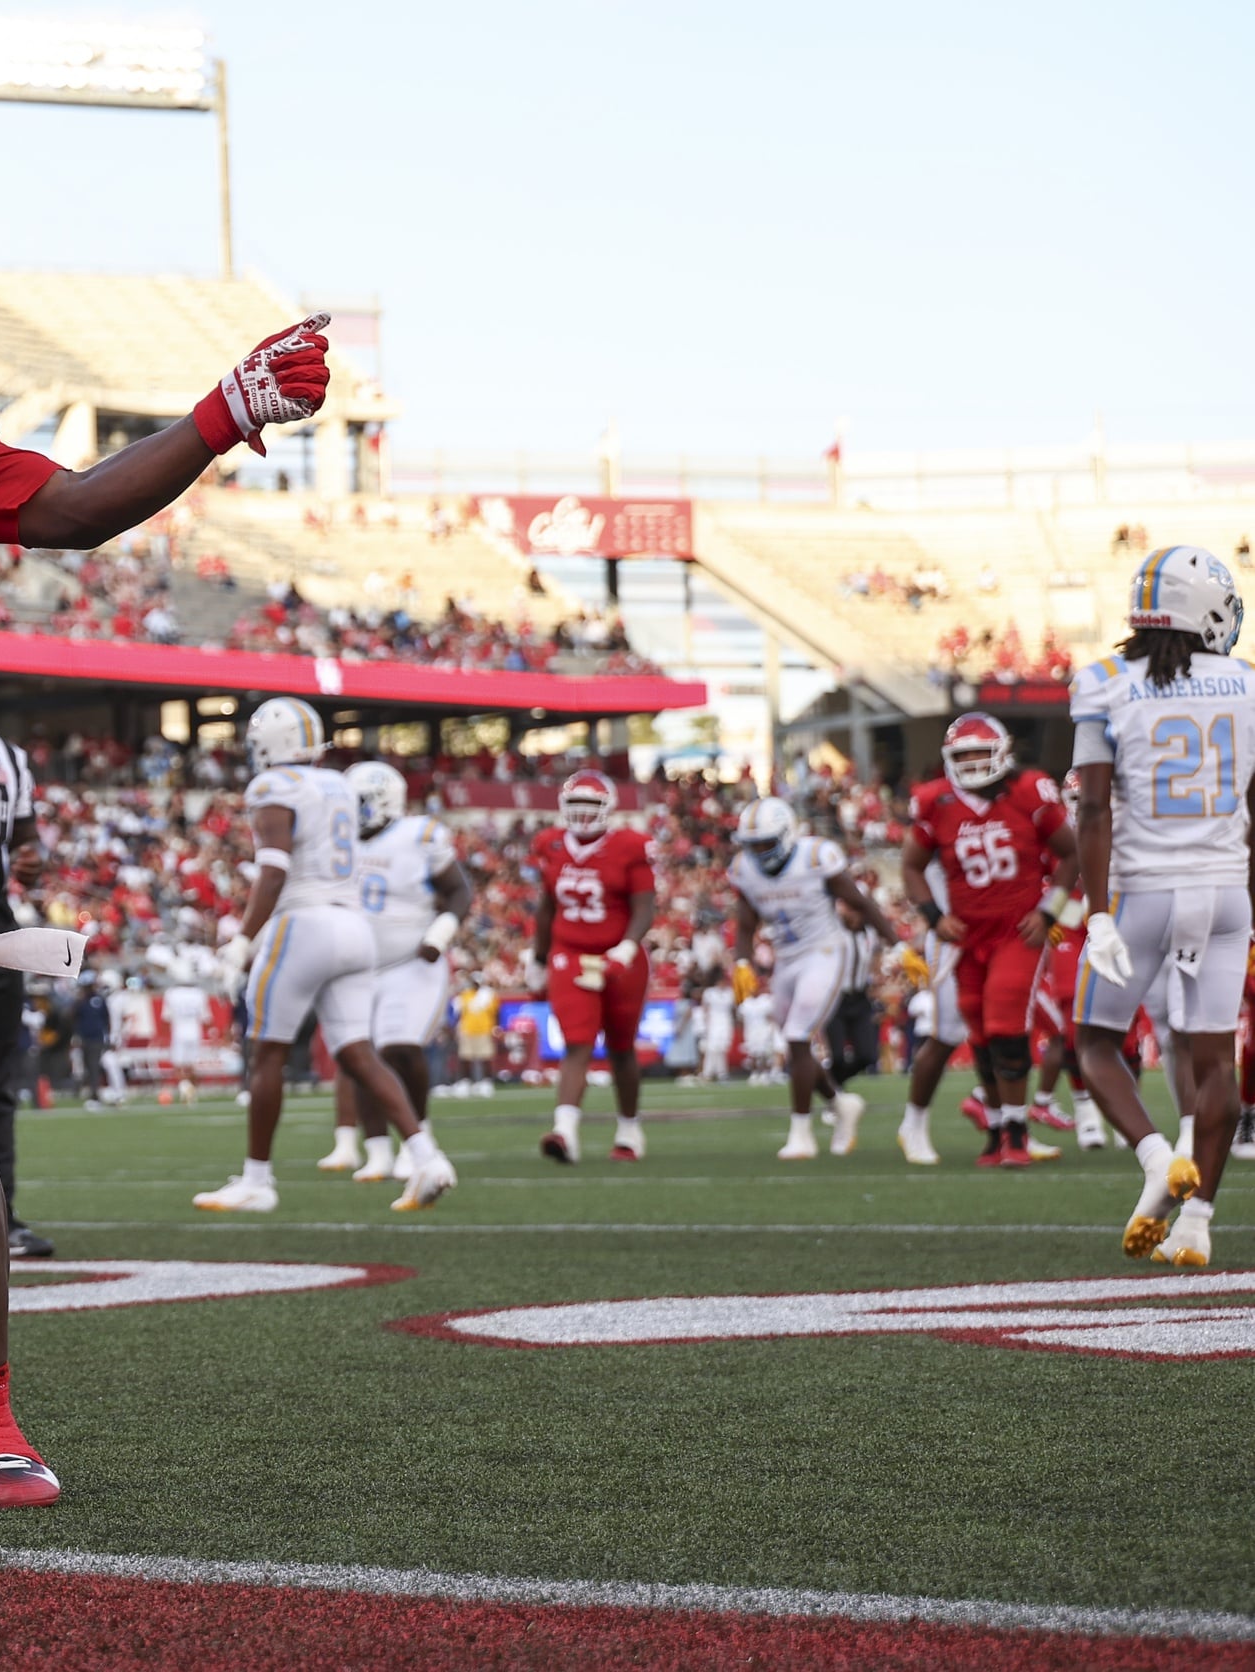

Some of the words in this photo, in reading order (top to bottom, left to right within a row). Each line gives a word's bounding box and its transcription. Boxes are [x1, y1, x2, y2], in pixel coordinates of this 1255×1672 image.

[1129, 676, 1246, 701] ANDERSON
[1151, 713, 1239, 818] 21
[954, 828, 1018, 889] 56
[555, 876, 607, 923] 53
